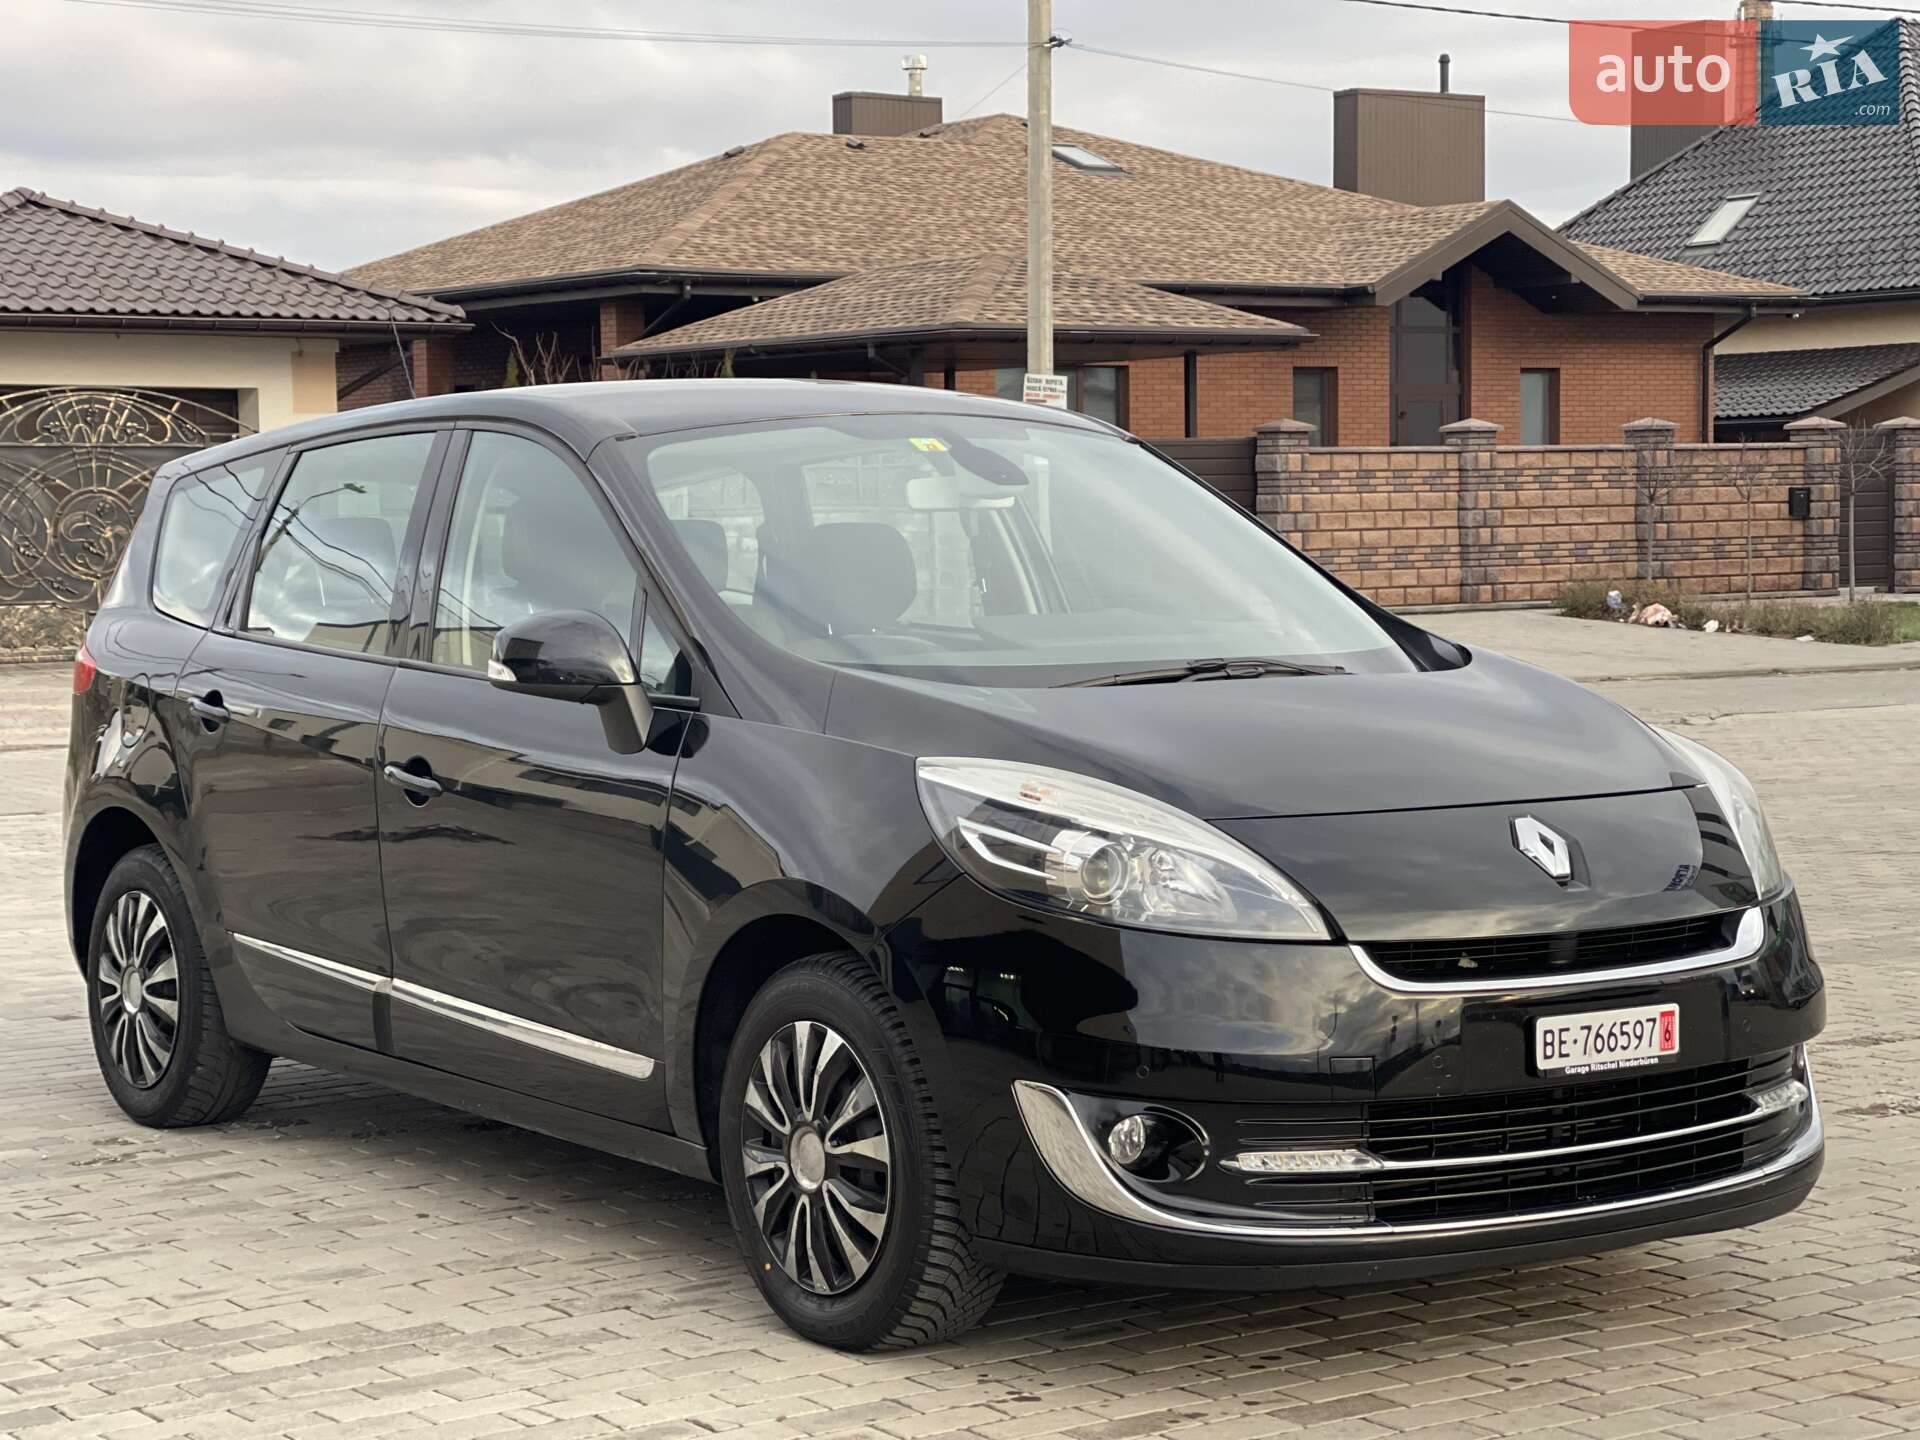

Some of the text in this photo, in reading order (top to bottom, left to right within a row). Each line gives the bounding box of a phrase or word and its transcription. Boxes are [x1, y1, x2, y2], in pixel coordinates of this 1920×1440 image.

[1664, 1021, 1672, 1042] 6
[1564, 1065, 1590, 1075] Garage
[1619, 1056, 1659, 1068] Niederbüren
